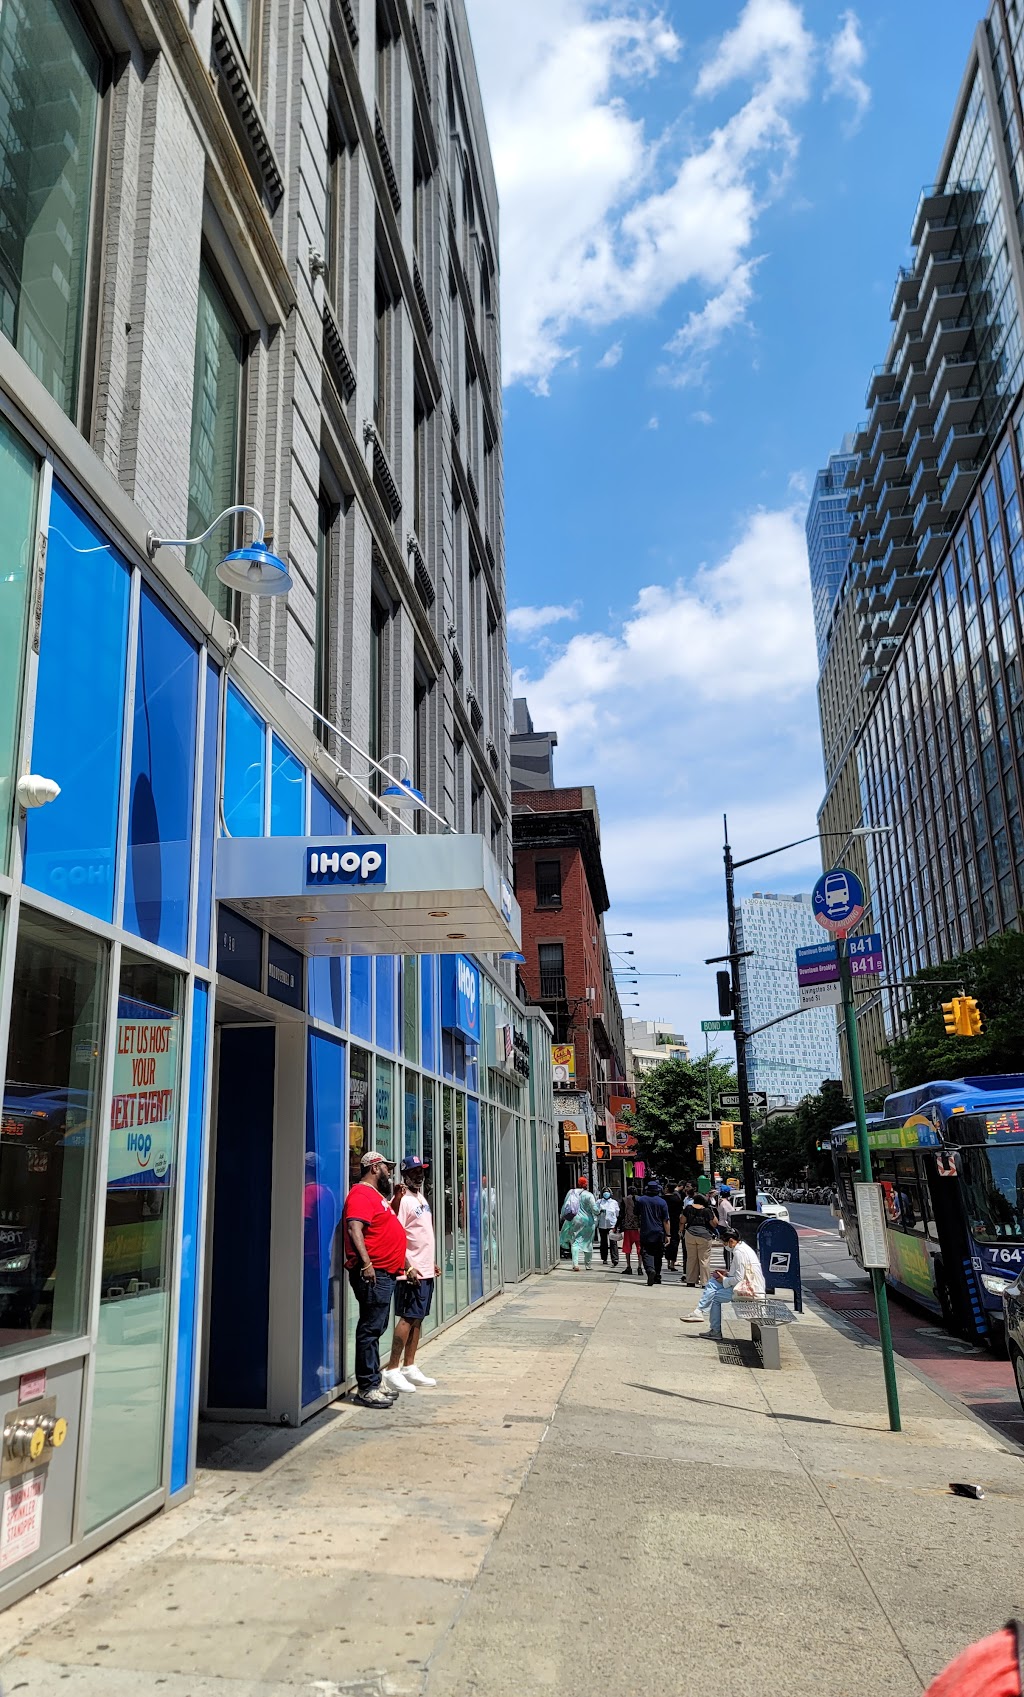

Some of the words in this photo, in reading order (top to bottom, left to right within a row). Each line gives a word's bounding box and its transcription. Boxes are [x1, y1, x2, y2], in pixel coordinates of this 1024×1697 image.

[311, 851, 382, 878] IHOP
[818, 914, 828, 925] NO
[829, 909, 859, 928] STANDING
[798, 947, 818, 957] Downtown
[818, 944, 836, 953] Brooklyn
[850, 937, 873, 954] B41
[799, 966, 819, 975] Downtown
[819, 963, 837, 973] Brooklyn
[851, 956, 874, 973] B41
[458, 957, 476, 1013] IHOP
[801, 985, 826, 995] Livingston
[826, 984, 832, 992] St
[802, 995, 814, 1003] Bond
[703, 1021, 720, 1031] BOND
[117, 1025, 136, 1054] LET
[136, 1025, 148, 1054] US
[149, 1025, 172, 1053] HOST
[132, 1058, 156, 1087] YOUR
[136, 1088, 174, 1126] EVENT!
[127, 1132, 152, 1158] IHOP
[989, 1248, 1024, 1263] 764
[7, 1482, 41, 1510] COMBINATION
[7, 1498, 36, 1528] SPRINKLER
[7, 1514, 36, 1543] STANDPIPE
